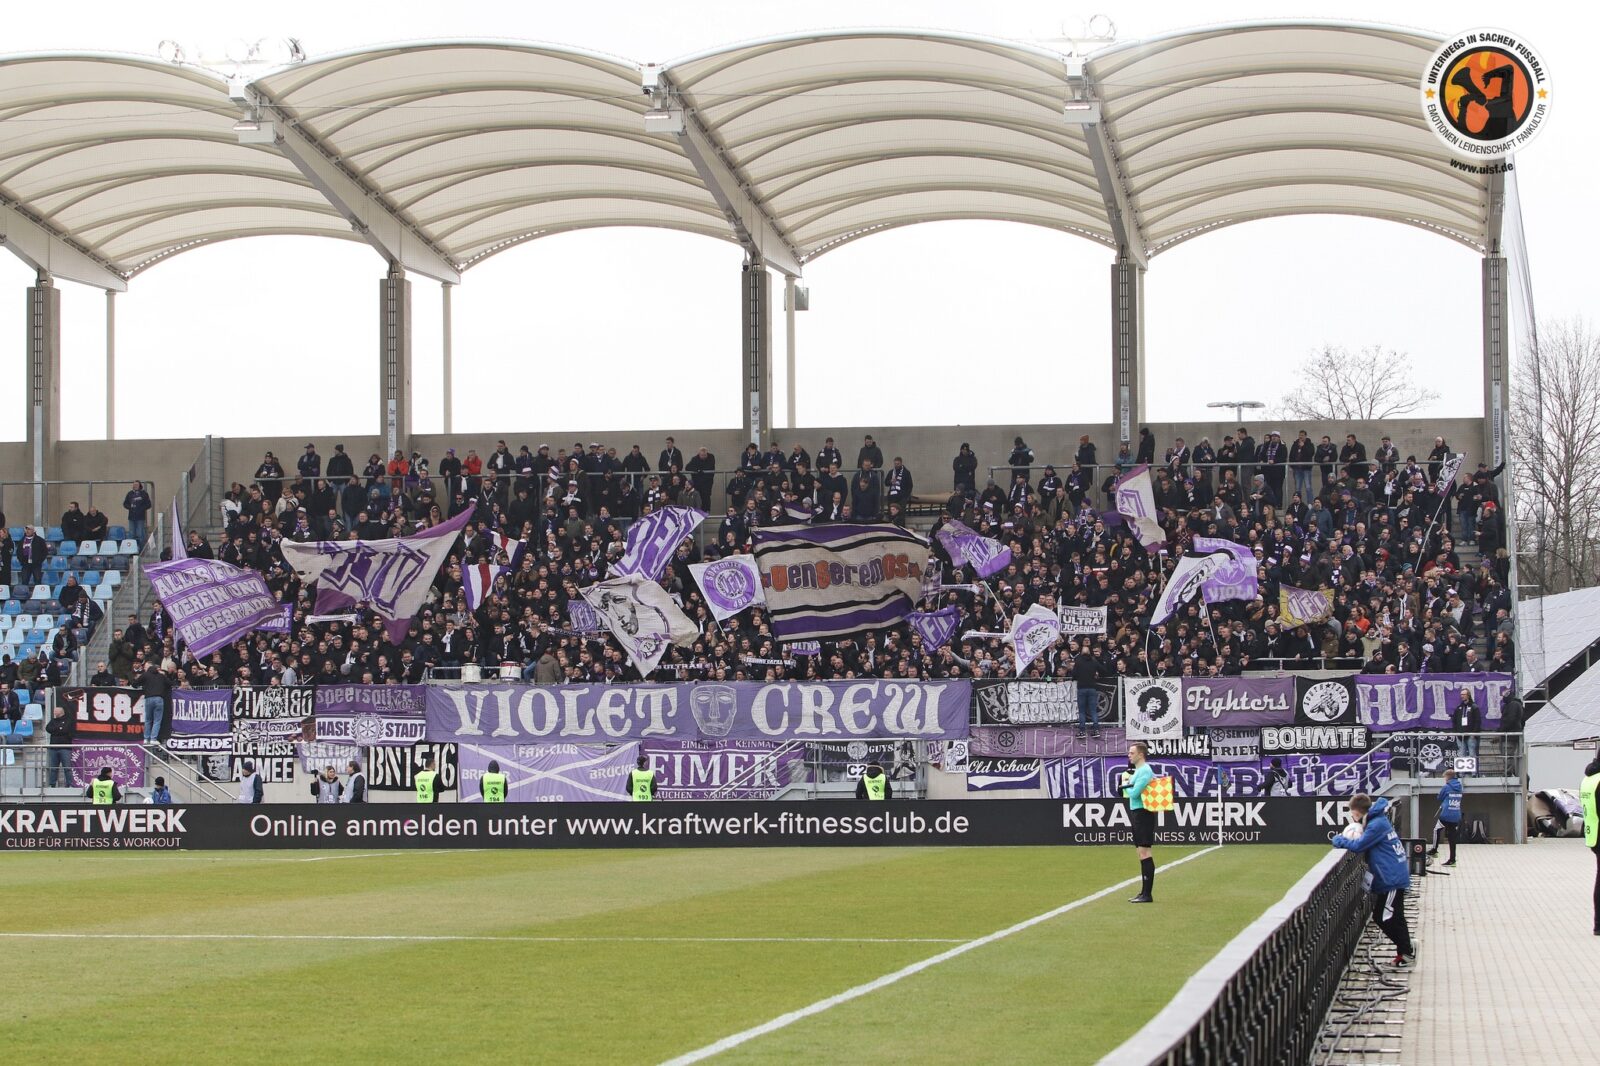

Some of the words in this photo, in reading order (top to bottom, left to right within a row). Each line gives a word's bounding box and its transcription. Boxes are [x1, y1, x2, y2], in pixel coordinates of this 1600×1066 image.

[154, 566, 214, 596] ALLES
[167, 586, 231, 620] VEREIN
[228, 578, 264, 598] UND
[181, 597, 275, 644] HASESTADT
[1064, 609, 1098, 617] INFERNO
[76, 692, 145, 722] 1984
[1186, 685, 1290, 718] Fighters
[172, 699, 228, 722] LILAHOLIKA
[443, 687, 678, 738] VIOLET
[751, 681, 948, 736] CREW
[112, 724, 123, 732] IS
[317, 721, 350, 736] HASE
[385, 722, 426, 738] STADT
[166, 737, 233, 749] GEHRDE
[681, 740, 710, 749] EIMER
[736, 740, 776, 749] KEINMAL
[1262, 726, 1367, 750] BOHMTE
[233, 742, 294, 755] LILA-WEISSE
[518, 744, 578, 757] FAN-CLUB
[869, 744, 894, 753] GUYS
[1212, 746, 1259, 756] TRIER
[306, 758, 350, 773] RHEIN
[647, 754, 780, 786] EIMER
[848, 765, 867, 776] C2
[968, 760, 991, 774] Old
[994, 758, 1040, 773] School
[1455, 758, 1474, 770] C3
[462, 769, 511, 781] BRER
[0, 809, 187, 833] KRAFTWERK
[1063, 802, 1267, 828] KRAWERK
[251, 814, 336, 836] Online
[346, 814, 477, 836] anmelden
[488, 816, 556, 836] unter
[566, 811, 969, 835] www.kraftwerk-fitnessclub.de
[6, 838, 35, 848] CLUB
[39, 836, 61, 847] FÜR
[65, 837, 110, 847] FITNESS
[113, 838, 120, 847] &
[124, 837, 181, 847] WORKOUT
[1075, 833, 1106, 842] CLUB
[1110, 831, 1133, 842] FÜR
[1188, 832, 1196, 841] &
[1200, 831, 1261, 841] WORKOUT
